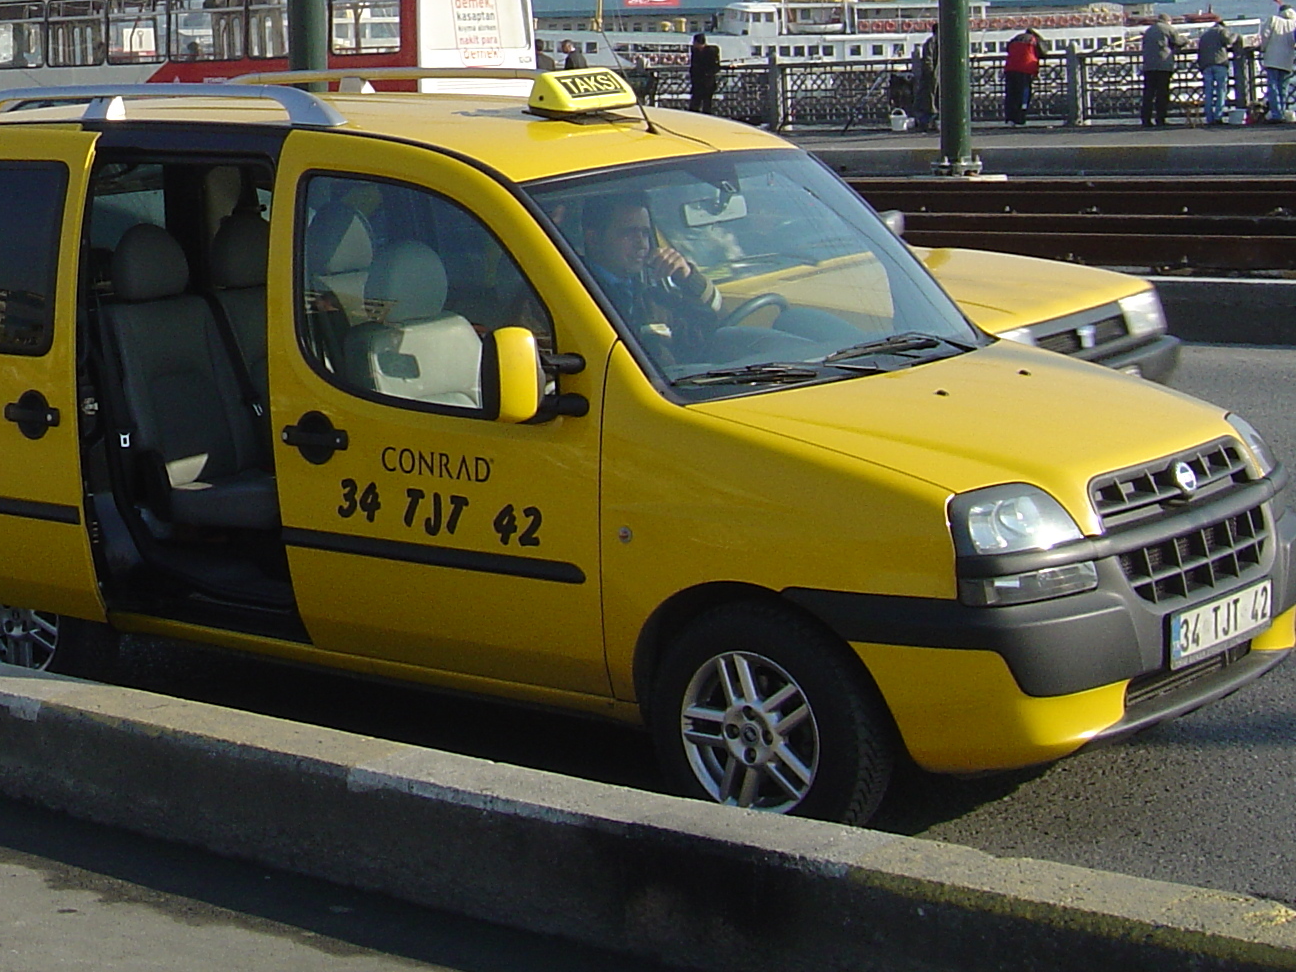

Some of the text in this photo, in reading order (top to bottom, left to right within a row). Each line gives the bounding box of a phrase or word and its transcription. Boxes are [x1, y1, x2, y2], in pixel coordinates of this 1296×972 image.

[456, 11, 496, 23] kasaptan
[481, 36, 498, 46] para
[381, 446, 491, 483] CONRAD
[337, 478, 543, 547] 34 TJT 42
[1179, 613, 1200, 653] 34
[1212, 597, 1240, 640] TJT
[1250, 586, 1268, 622] 42
